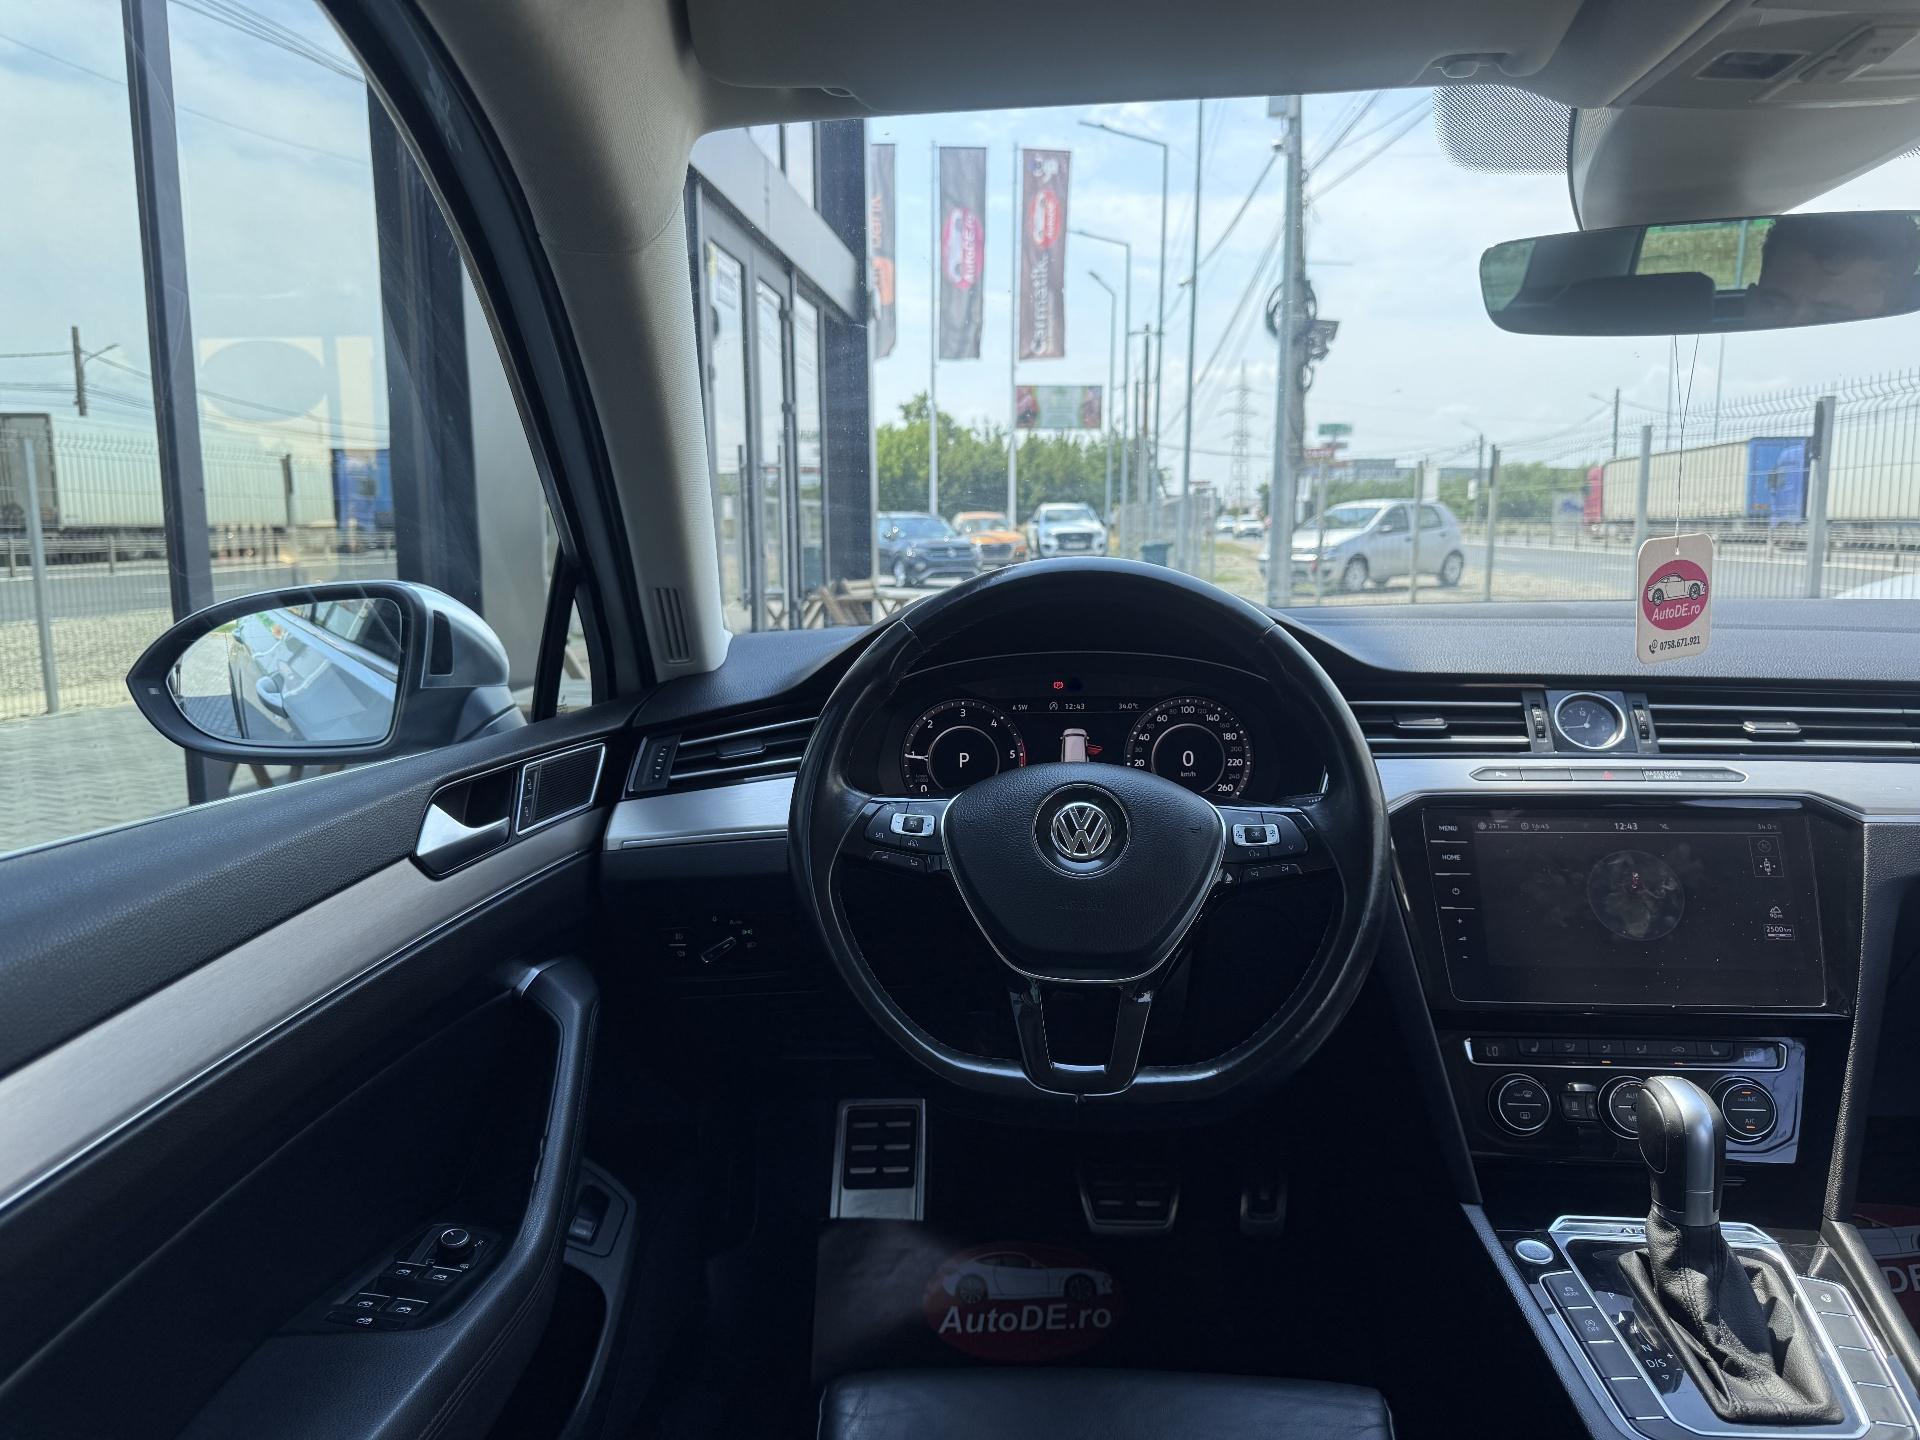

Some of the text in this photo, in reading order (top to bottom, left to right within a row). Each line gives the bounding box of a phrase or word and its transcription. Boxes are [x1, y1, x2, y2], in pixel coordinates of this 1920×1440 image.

[1652, 603, 1701, 621] AutoDE.ro
[1659, 635, 1701, 651] 0758.671.921
[959, 708, 966, 718] 3
[1180, 706, 1195, 714] 100
[1156, 714, 1168, 722] 60
[1206, 713, 1220, 722] 140
[927, 719, 934, 729] 2
[990, 719, 998, 728] 4
[1138, 733, 1150, 741] 40
[1222, 732, 1237, 741] 180
[1009, 750, 1016, 759] 5
[1182, 750, 1194, 767] 0
[959, 752, 970, 768] P
[1133, 759, 1145, 767] 20
[1226, 758, 1243, 767] 220
[1180, 770, 1197, 778] km/h
[1217, 784, 1234, 792] 260
[1614, 822, 1638, 830] 12:43
[938, 1304, 1112, 1335] AutoDE.ro
[1641, 1344, 1653, 1352] N
[1645, 1359, 1667, 1369] D/S
